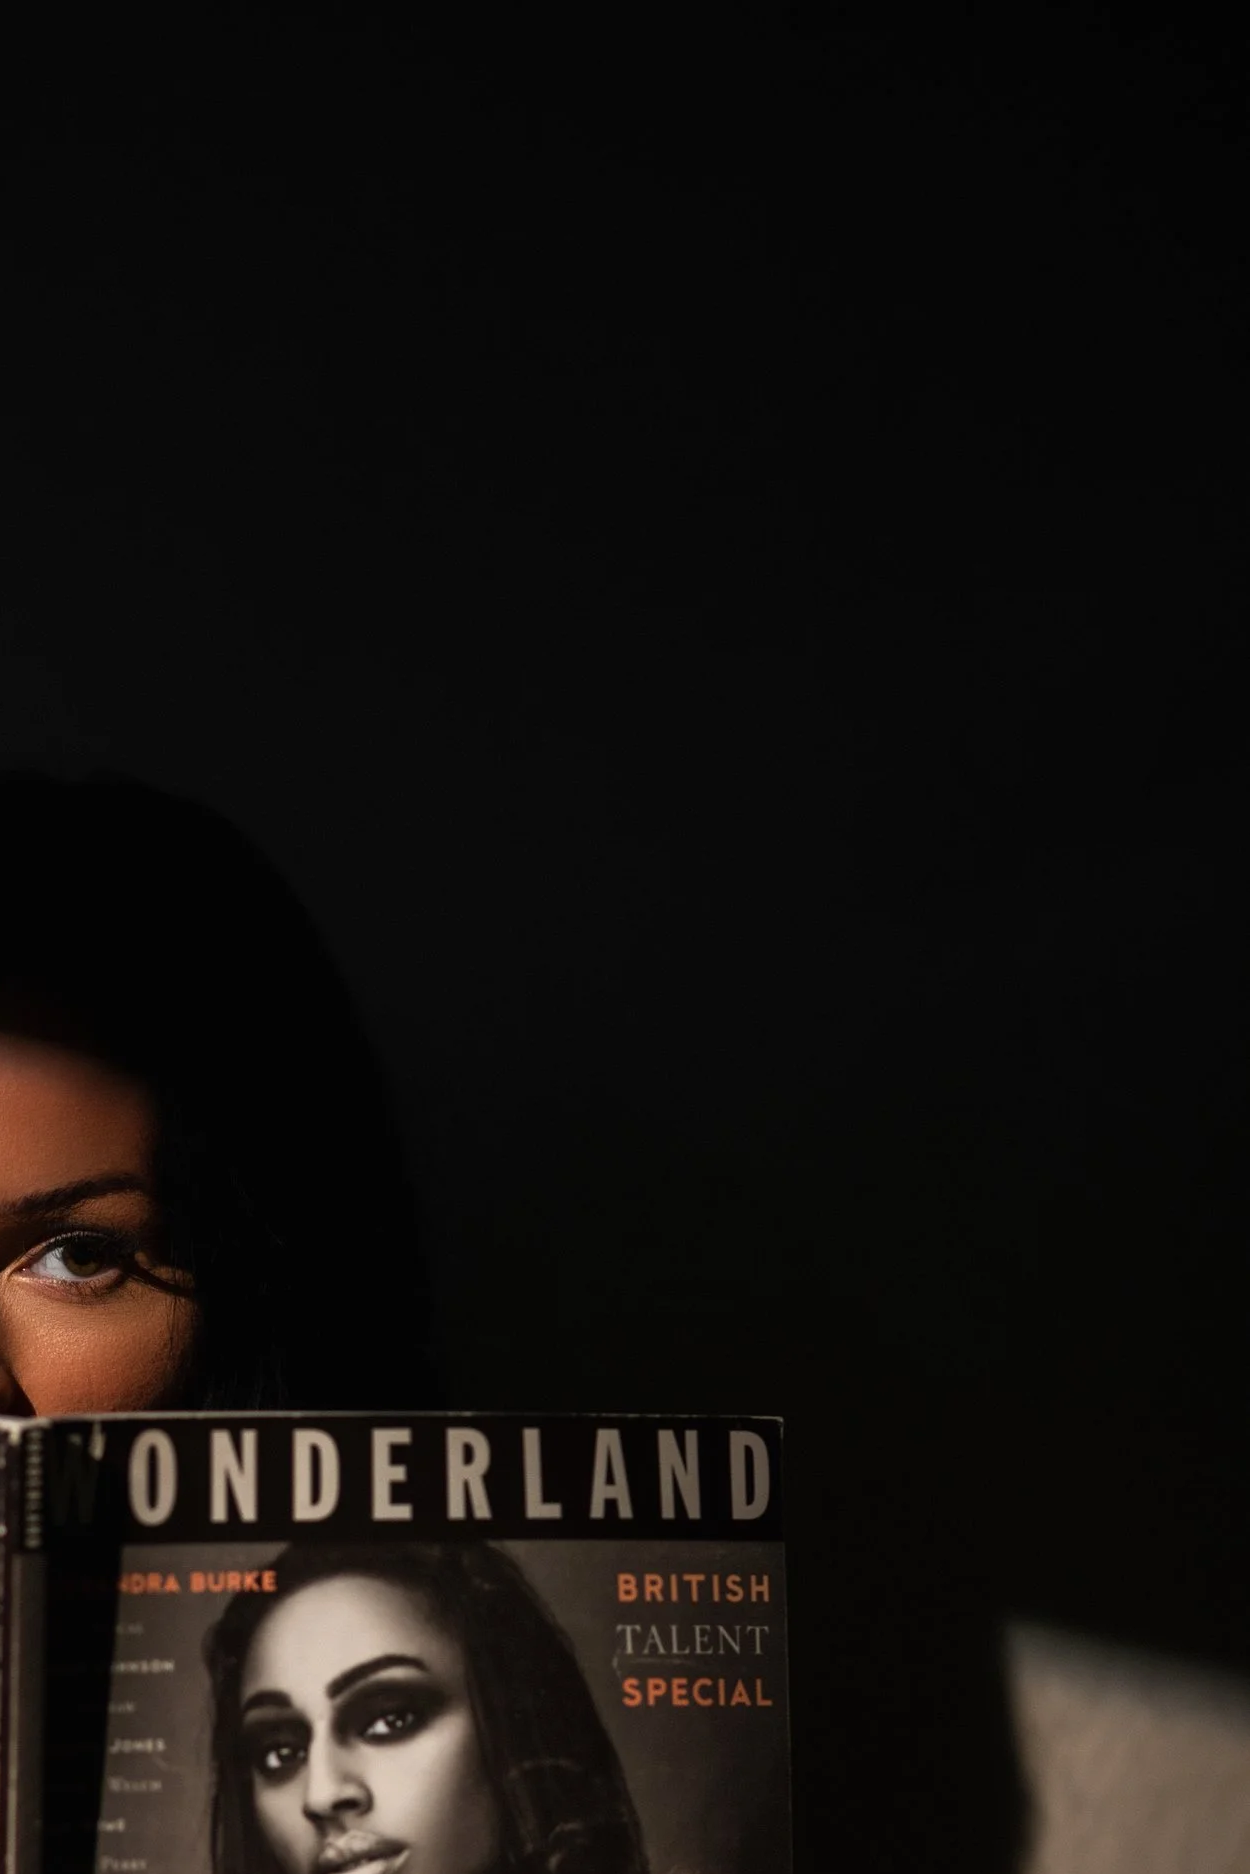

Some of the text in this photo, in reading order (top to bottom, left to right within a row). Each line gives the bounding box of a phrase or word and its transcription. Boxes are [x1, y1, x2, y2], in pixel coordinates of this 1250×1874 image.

[189, 1570, 278, 1594] BURKE
[617, 1573, 770, 1603] BRITISH
[616, 1624, 770, 1655] TALENT
[622, 1677, 774, 1708] SPECIAL
